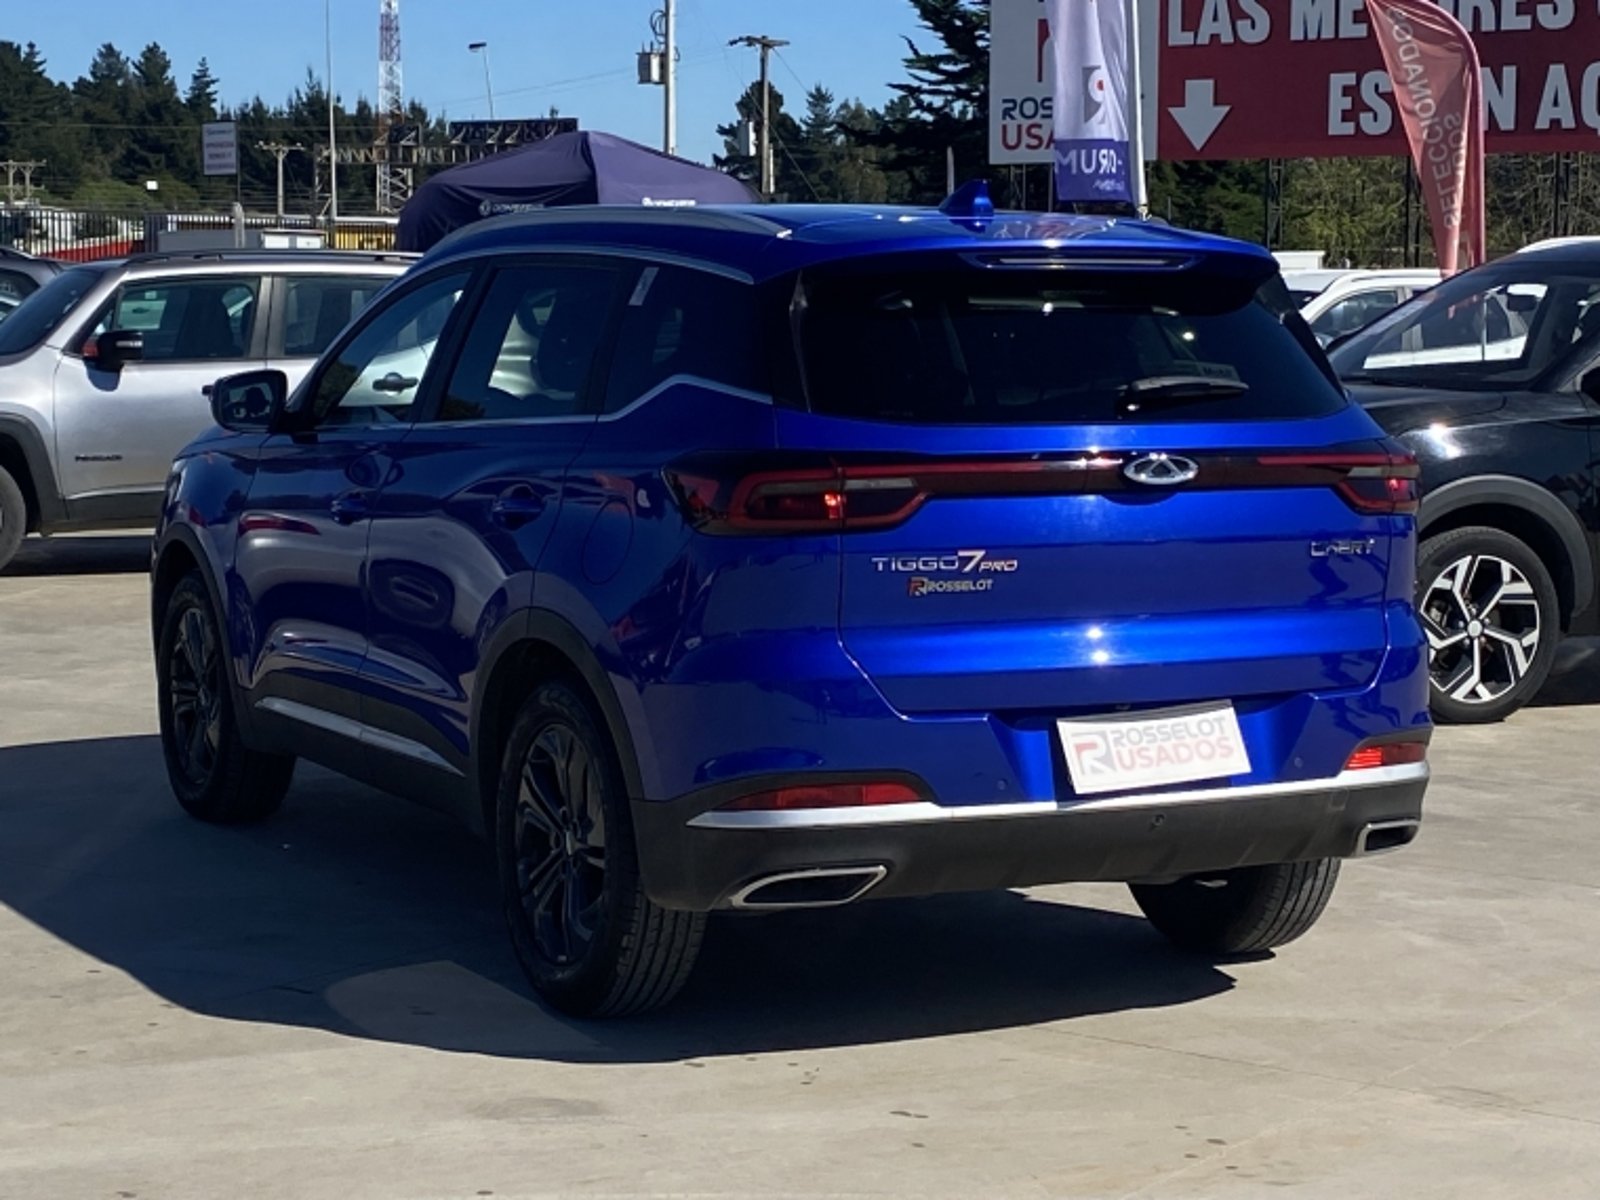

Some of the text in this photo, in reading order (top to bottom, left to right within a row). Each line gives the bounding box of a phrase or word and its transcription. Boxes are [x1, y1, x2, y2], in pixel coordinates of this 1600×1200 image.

[1168, 0, 1271, 46] LAS
[1328, 65, 1517, 136] ESN
[1110, 716, 1226, 748] ROSSELOT
[1116, 737, 1235, 771] USADOS
